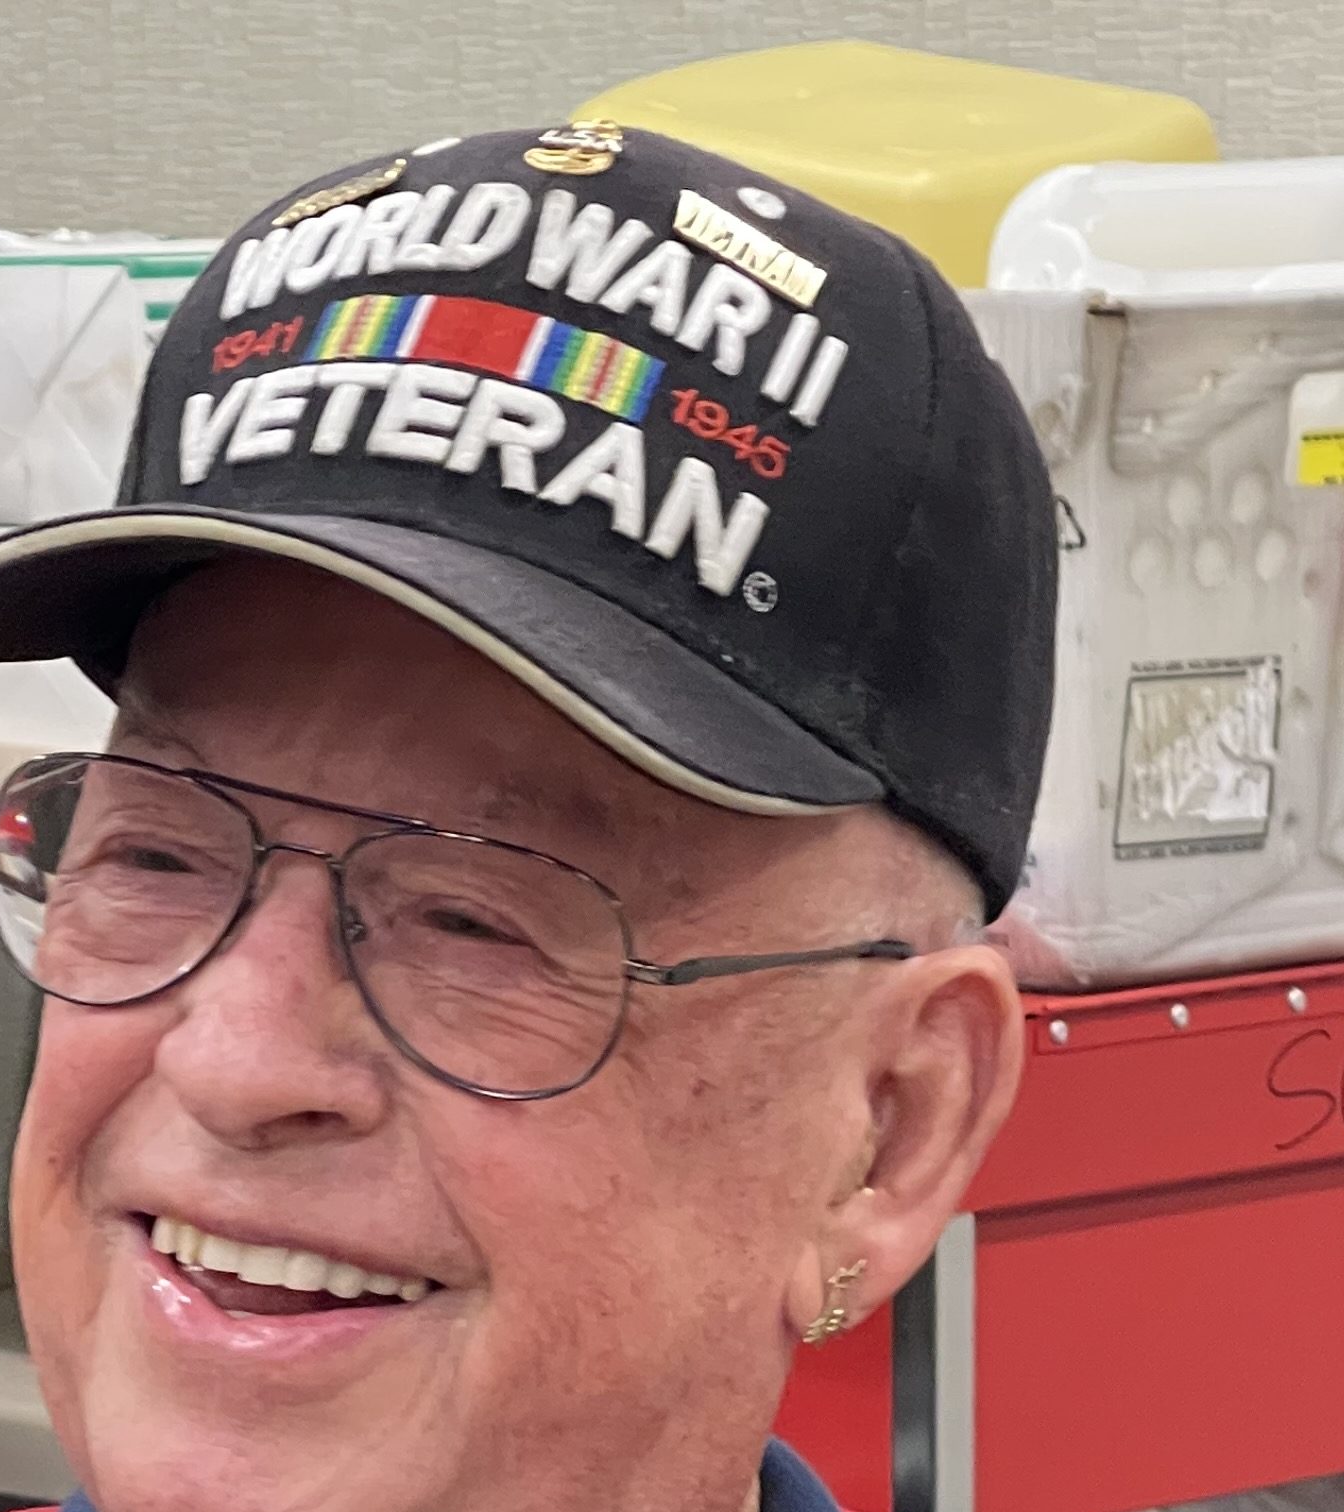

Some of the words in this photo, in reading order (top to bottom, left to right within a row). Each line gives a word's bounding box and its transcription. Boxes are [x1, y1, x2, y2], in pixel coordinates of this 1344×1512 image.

[211, 316, 304, 373] 1941
[219, 183, 532, 320] WORLD
[524, 188, 771, 376] WAR
[760, 313, 849, 427] II
[179, 361, 771, 598] VETERAN
[670, 388, 792, 479] 1945
